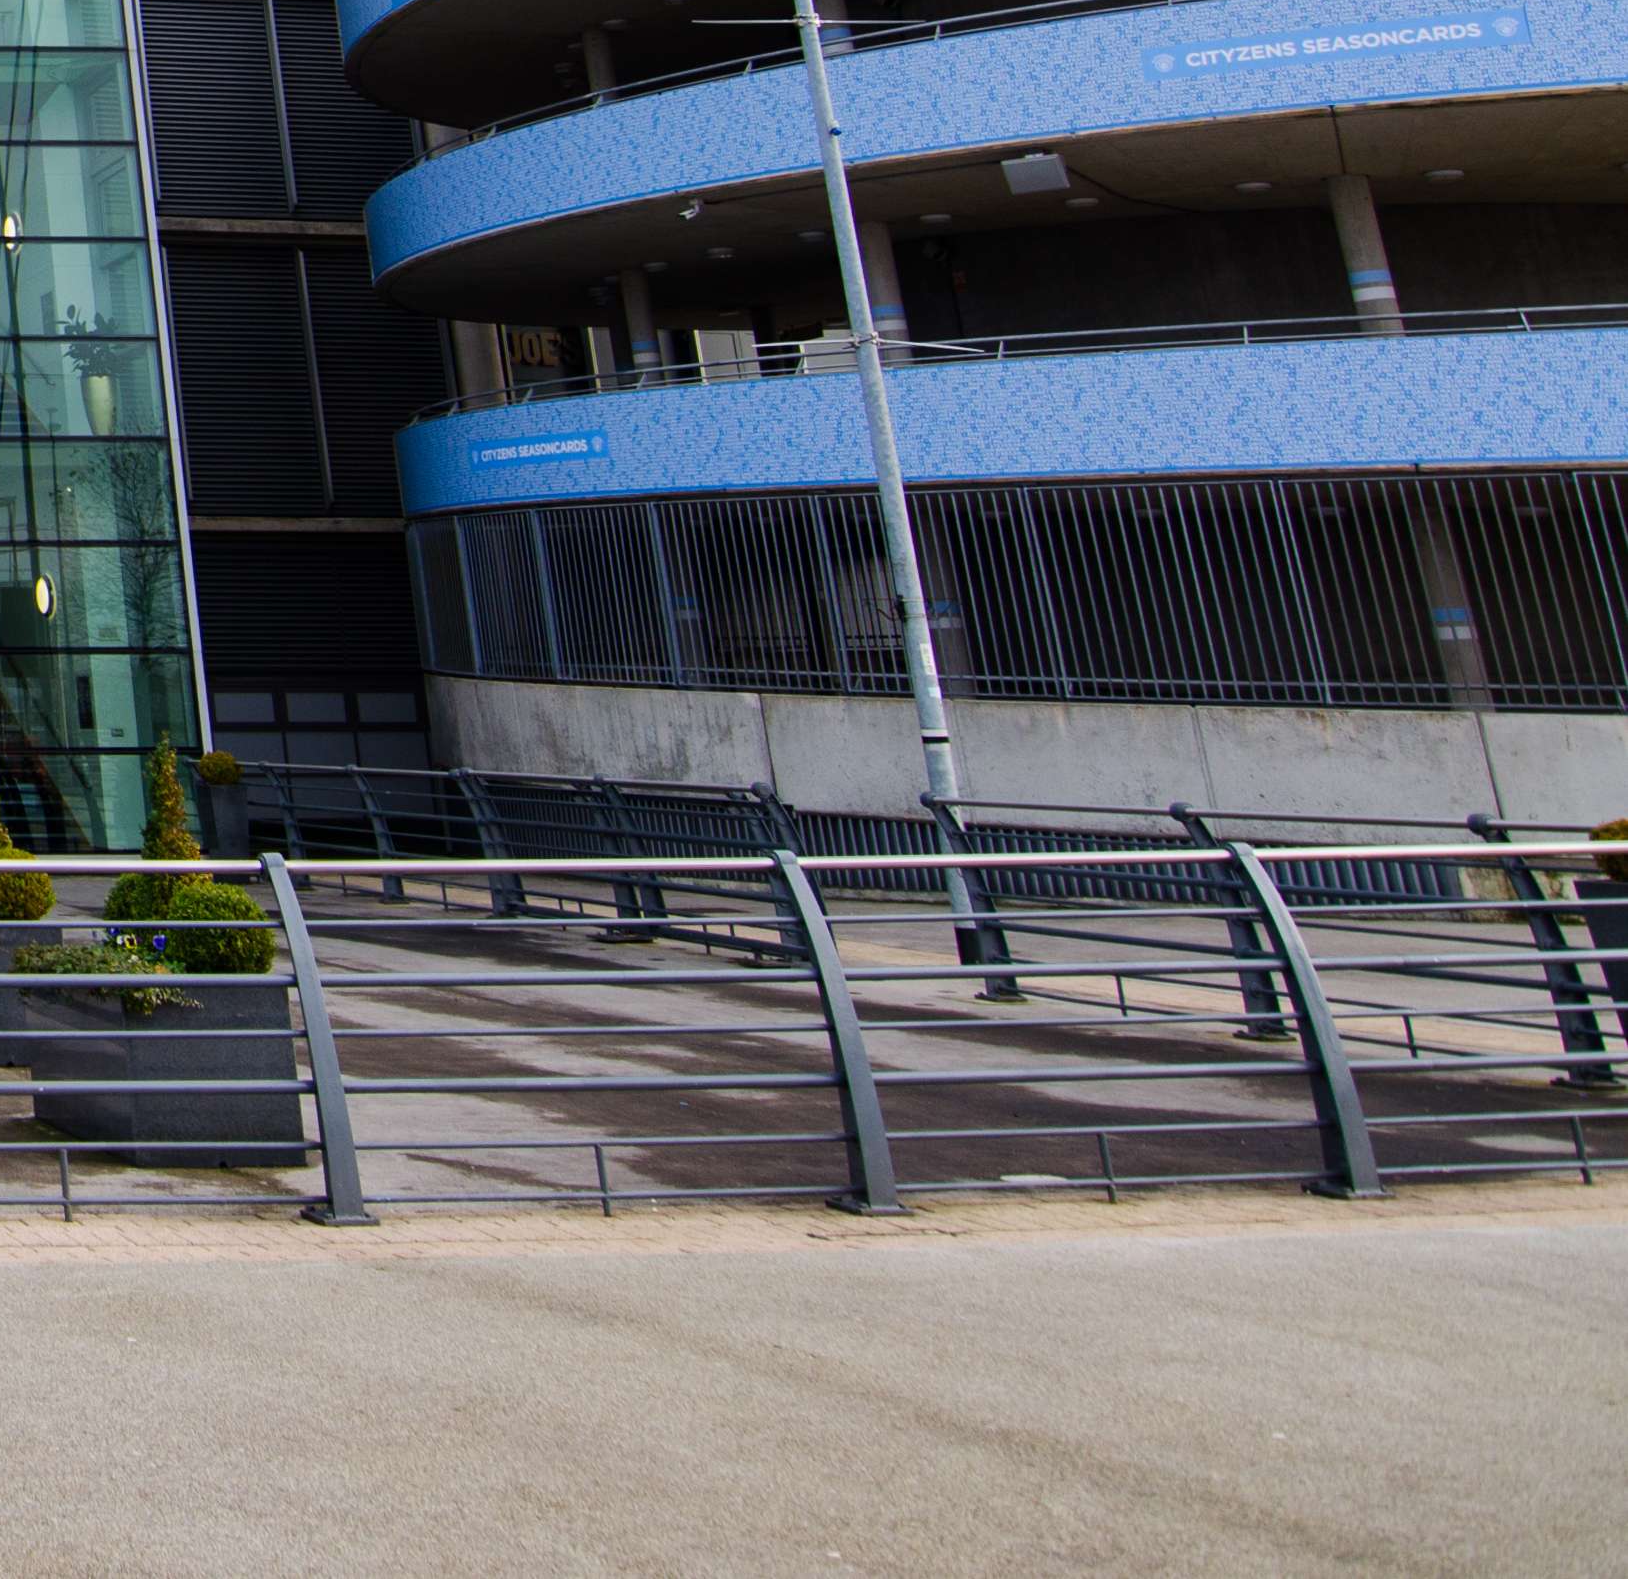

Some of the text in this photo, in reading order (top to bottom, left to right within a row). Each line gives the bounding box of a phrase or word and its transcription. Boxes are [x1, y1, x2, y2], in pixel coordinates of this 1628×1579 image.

[1185, 21, 1482, 68] CITYZENS SEASONCARDS
[480, 439, 588, 463] CITYZENS SEASONCARDS
